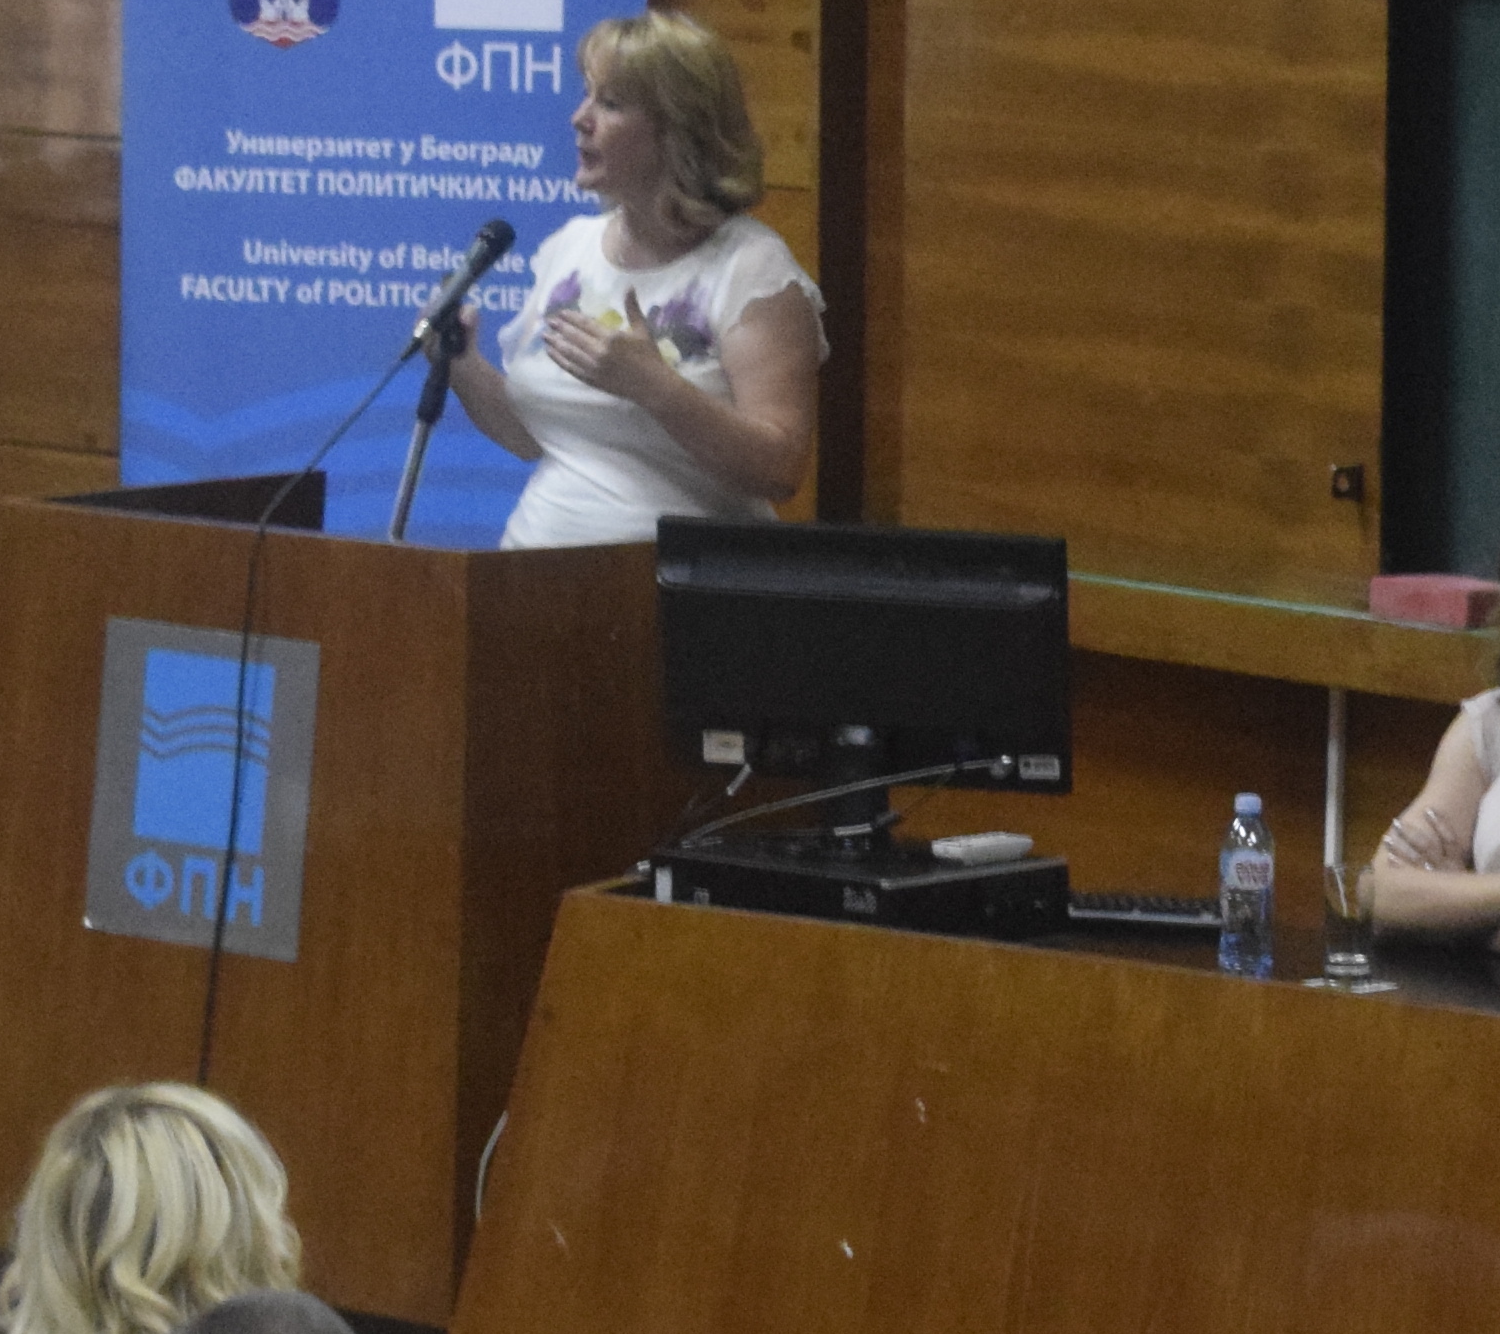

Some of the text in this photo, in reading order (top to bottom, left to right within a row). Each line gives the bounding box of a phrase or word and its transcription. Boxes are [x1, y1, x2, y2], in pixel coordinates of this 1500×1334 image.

[435, 40, 563, 95] ФПН
[225, 129, 544, 168] Универзитет у Београду
[174, 165, 311, 196] ФАКУЛТЕТ
[317, 170, 502, 202] ПОЛИТИЧКИХ
[243, 239, 371, 274] University
[379, 242, 407, 270] of
[181, 274, 291, 304] FACULTY
[297, 278, 324, 305] of
[124, 849, 266, 927] ФПН
